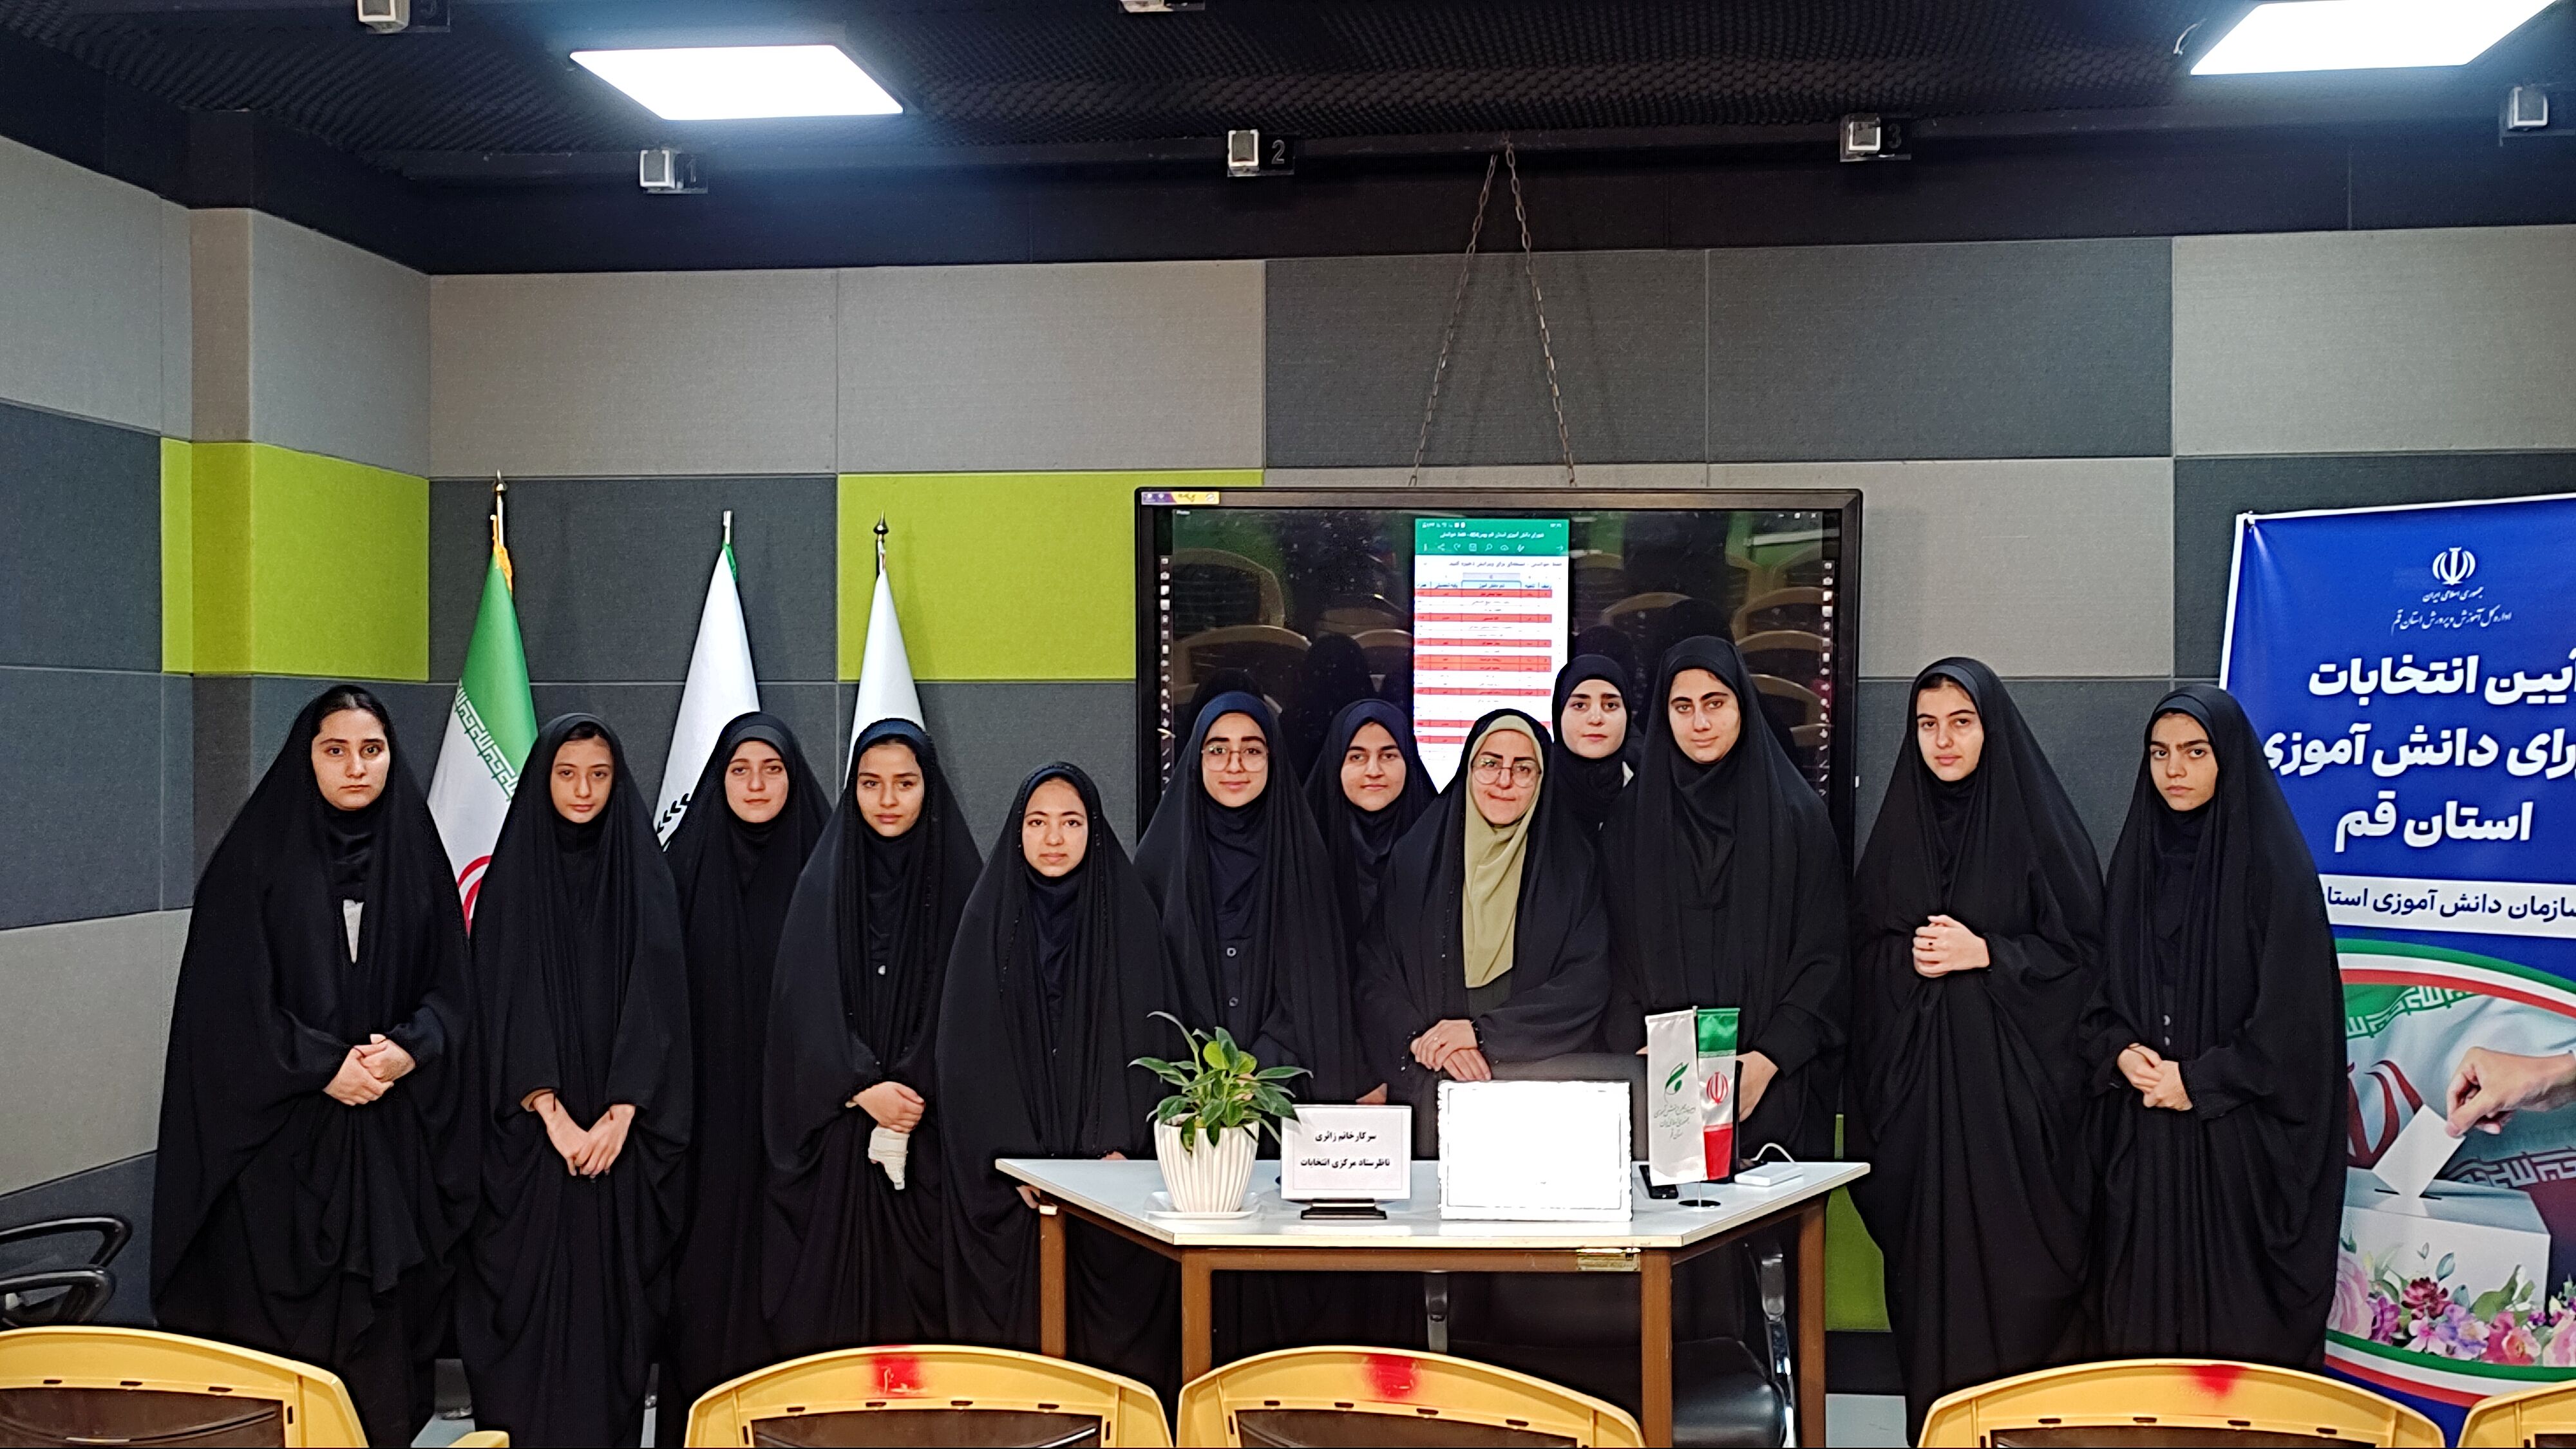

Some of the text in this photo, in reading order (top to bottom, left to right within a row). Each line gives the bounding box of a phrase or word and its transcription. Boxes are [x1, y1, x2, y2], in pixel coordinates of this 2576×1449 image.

[1887, 123, 1902, 149] 3
[1271, 138, 1286, 166] 2
[2309, 654, 2479, 706] انتخابات
[2371, 724, 2499, 777] دانش
[2334, 790, 2533, 853] استان قم
[2327, 886, 2369, 907] استا
[2372, 889, 2438, 915] آموزی
[2439, 893, 2502, 917] دانش
[1300, 1158, 1330, 1168] انتخابات
